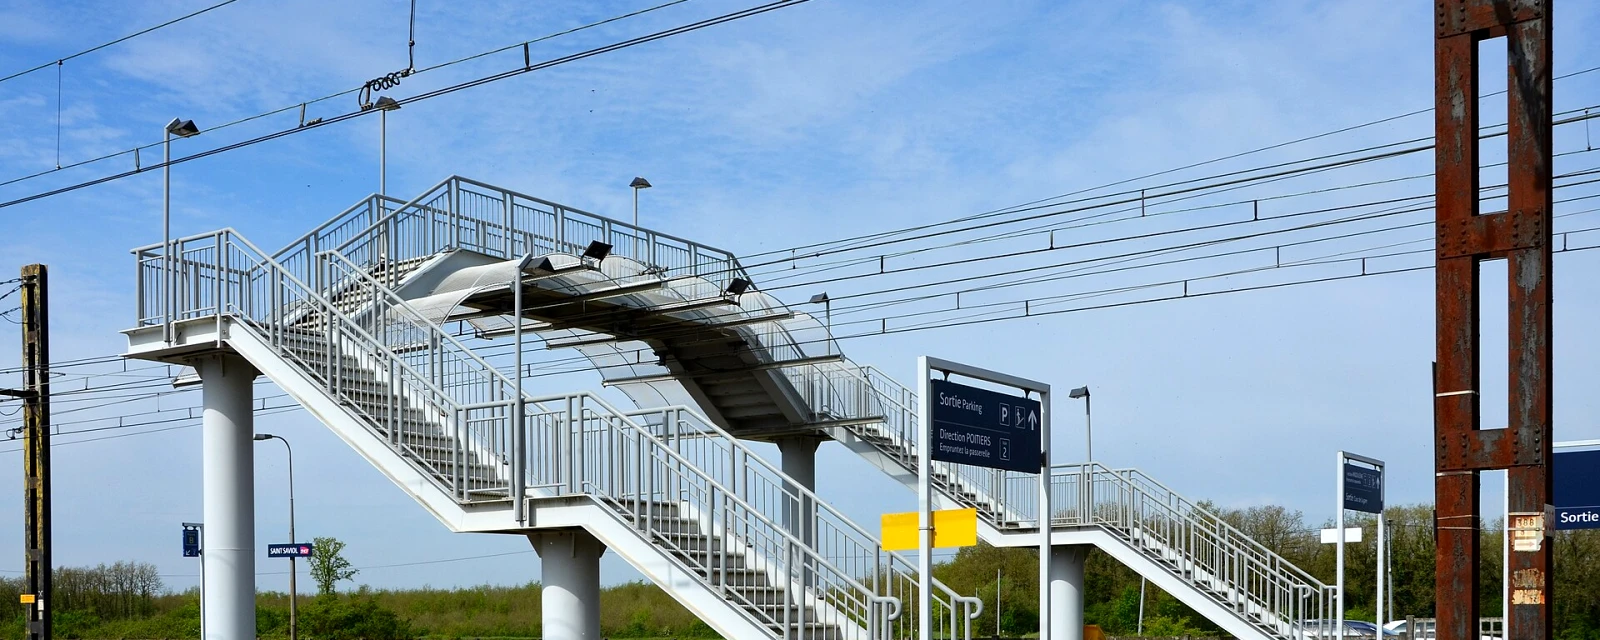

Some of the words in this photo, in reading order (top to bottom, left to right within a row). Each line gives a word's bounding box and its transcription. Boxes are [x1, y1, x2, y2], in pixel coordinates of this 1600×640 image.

[940, 392, 961, 408] Sortie
[963, 399, 982, 415] Parking
[1002, 407, 1008, 422] P
[940, 428, 965, 442] Direction
[967, 432, 991, 446] POITIERS
[940, 442, 964, 454] Empruntez
[965, 446, 969, 455] la
[969, 448, 990, 458] passerelle
[1003, 447, 1007, 458] 2
[1560, 511, 1599, 523] Sortie
[270, 547, 282, 555] SAINT
